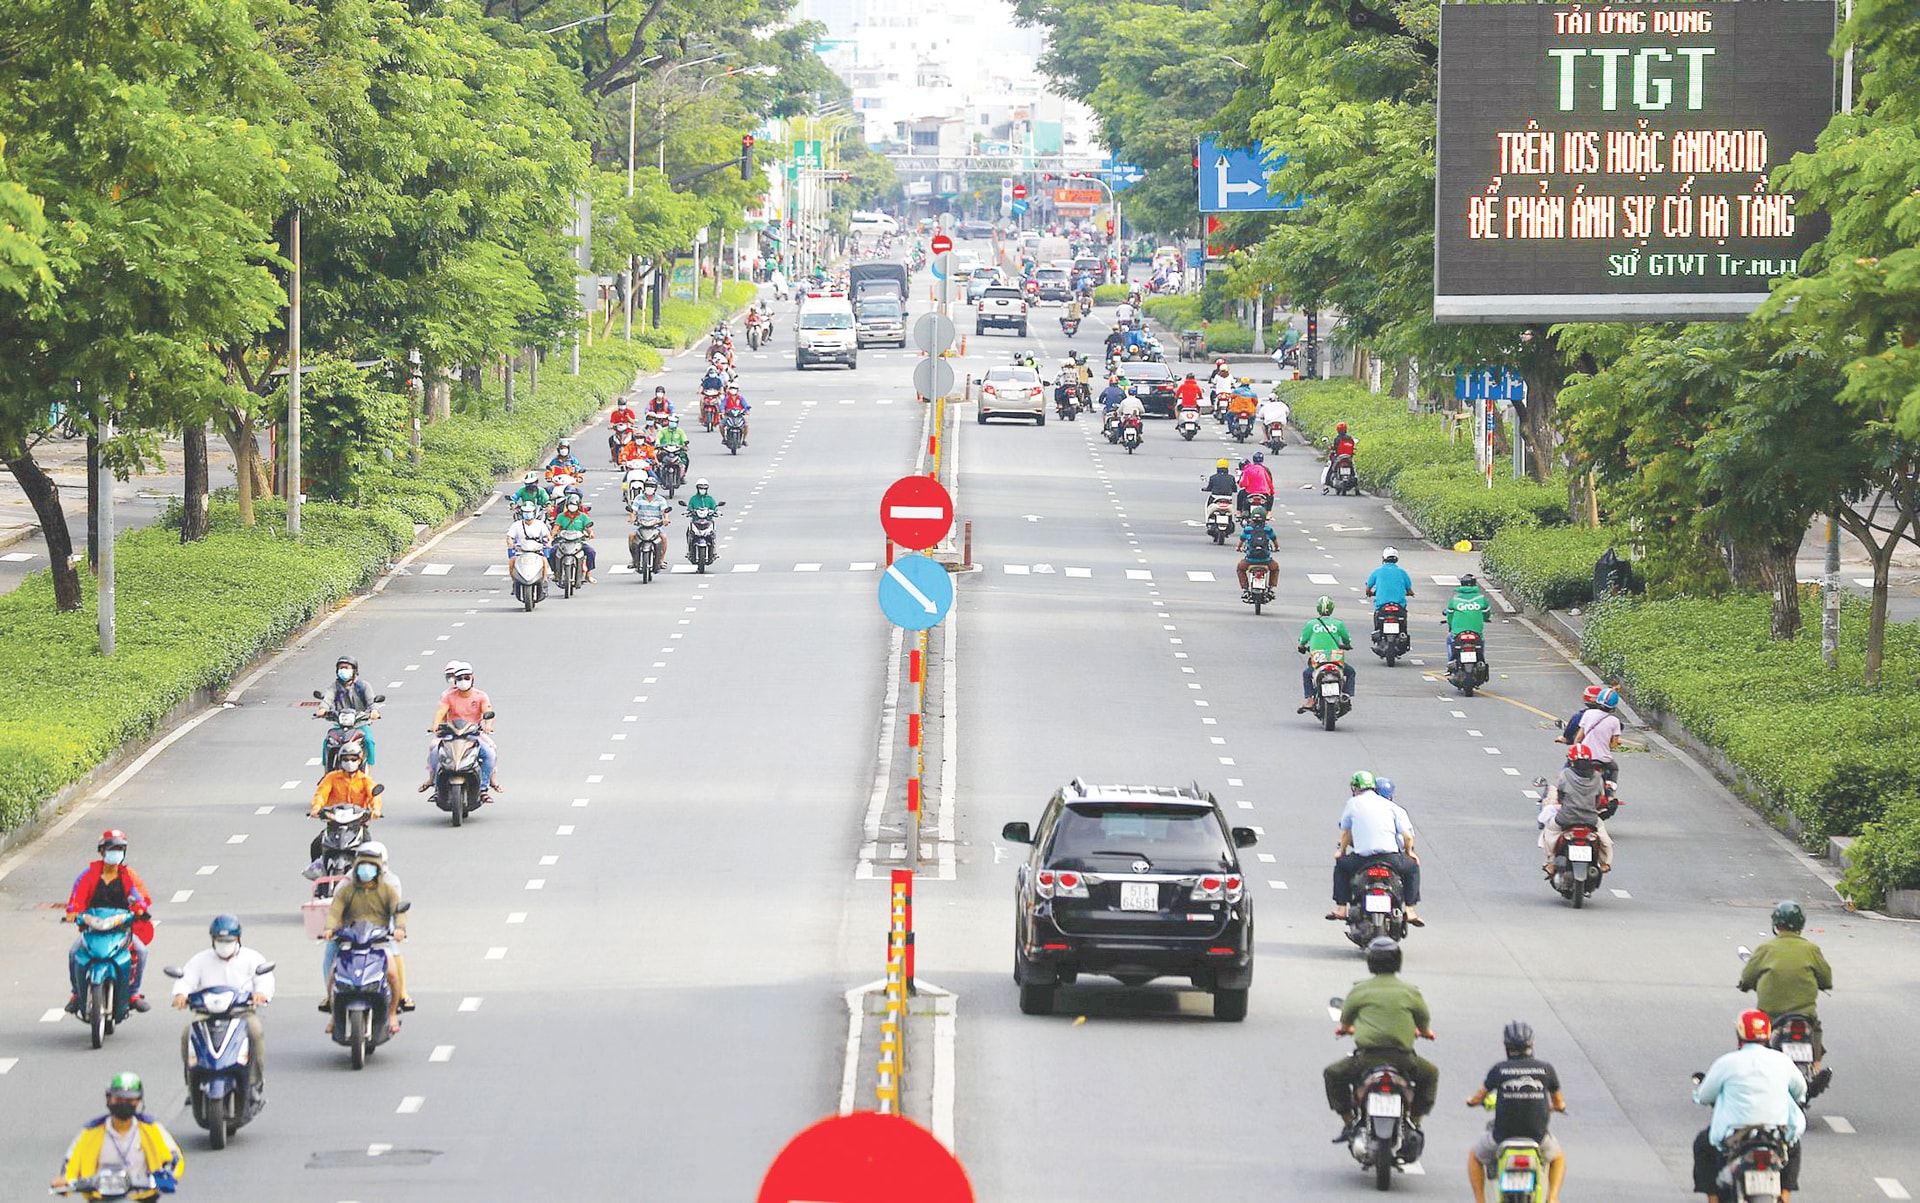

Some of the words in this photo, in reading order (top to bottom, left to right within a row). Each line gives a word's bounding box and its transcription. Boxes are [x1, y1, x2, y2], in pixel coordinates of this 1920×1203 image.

[1554, 4, 1591, 34] TẢI
[1598, 5, 1647, 34] ỨNG
[1654, 11, 1713, 38] DỤNG
[1548, 47, 1716, 111] TTGT
[1497, 119, 1555, 174] TRÊN
[1563, 131, 1599, 174] IOS
[1606, 118, 1664, 181] HOẶC
[1672, 130, 1768, 173] ANDROID
[1468, 176, 1501, 239] ĐỂ
[1506, 180, 1564, 239] PHẢN
[1571, 184, 1615, 238] ÁNH
[1622, 195, 1656, 246] SỰ
[1662, 175, 1694, 238] CỐ
[1700, 195, 1730, 246] HẠ
[1736, 173, 1796, 238] TẦNG
[1608, 248, 1640, 277] SỞ
[1648, 253, 1708, 276] GTVT
[1456, 602, 1481, 611] Grab
[1312, 623, 1338, 634] Grab
[1130, 885, 1150, 897] 51A
